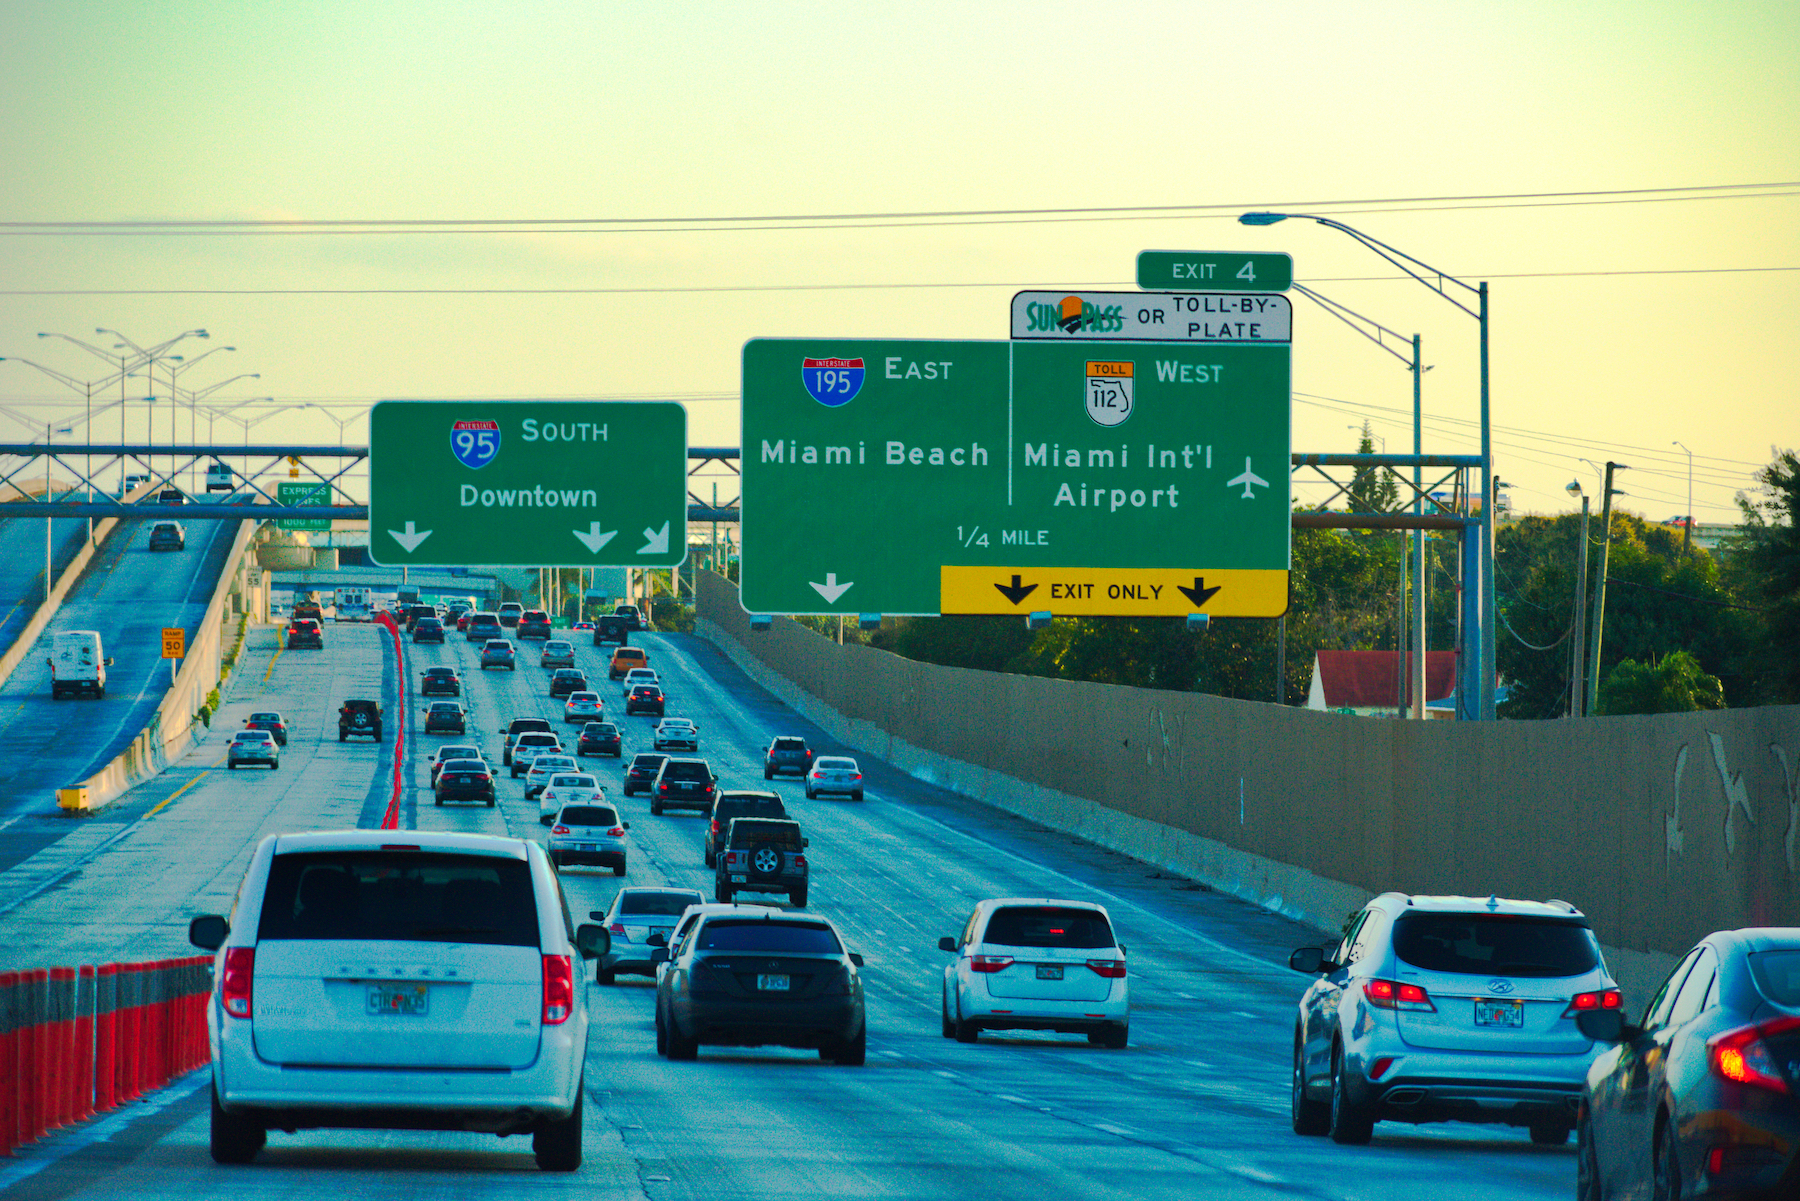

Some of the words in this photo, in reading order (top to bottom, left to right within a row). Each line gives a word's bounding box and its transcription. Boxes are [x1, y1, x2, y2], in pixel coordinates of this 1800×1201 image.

[1173, 263, 1217, 279] EXIT
[1236, 261, 1256, 283] 4
[1138, 309, 1165, 324] OR
[1173, 297, 1277, 313] TOLL-BY-
[1188, 323, 1261, 338] PLATE
[885, 357, 953, 380] EAST
[1094, 364, 1126, 375] TOLL
[1155, 360, 1224, 384] WEST
[816, 370, 851, 393] 195
[1093, 389, 1117, 408] 112
[521, 418, 608, 442] SOUTH
[456, 431, 495, 459] 95
[761, 439, 865, 464] Miami
[886, 441, 988, 466] Beach
[1024, 443, 1128, 468] Miami
[1148, 444, 1212, 469] Int'l
[460, 484, 597, 507] Downtown
[1053, 483, 1179, 513] Airport
[957, 525, 990, 548] 1/4
[1002, 529, 1049, 545] MILE
[247, 577, 260, 586] 55
[1051, 583, 1095, 599] EXIT
[1108, 584, 1163, 600] ONLY
[166, 641, 181, 651] 50
